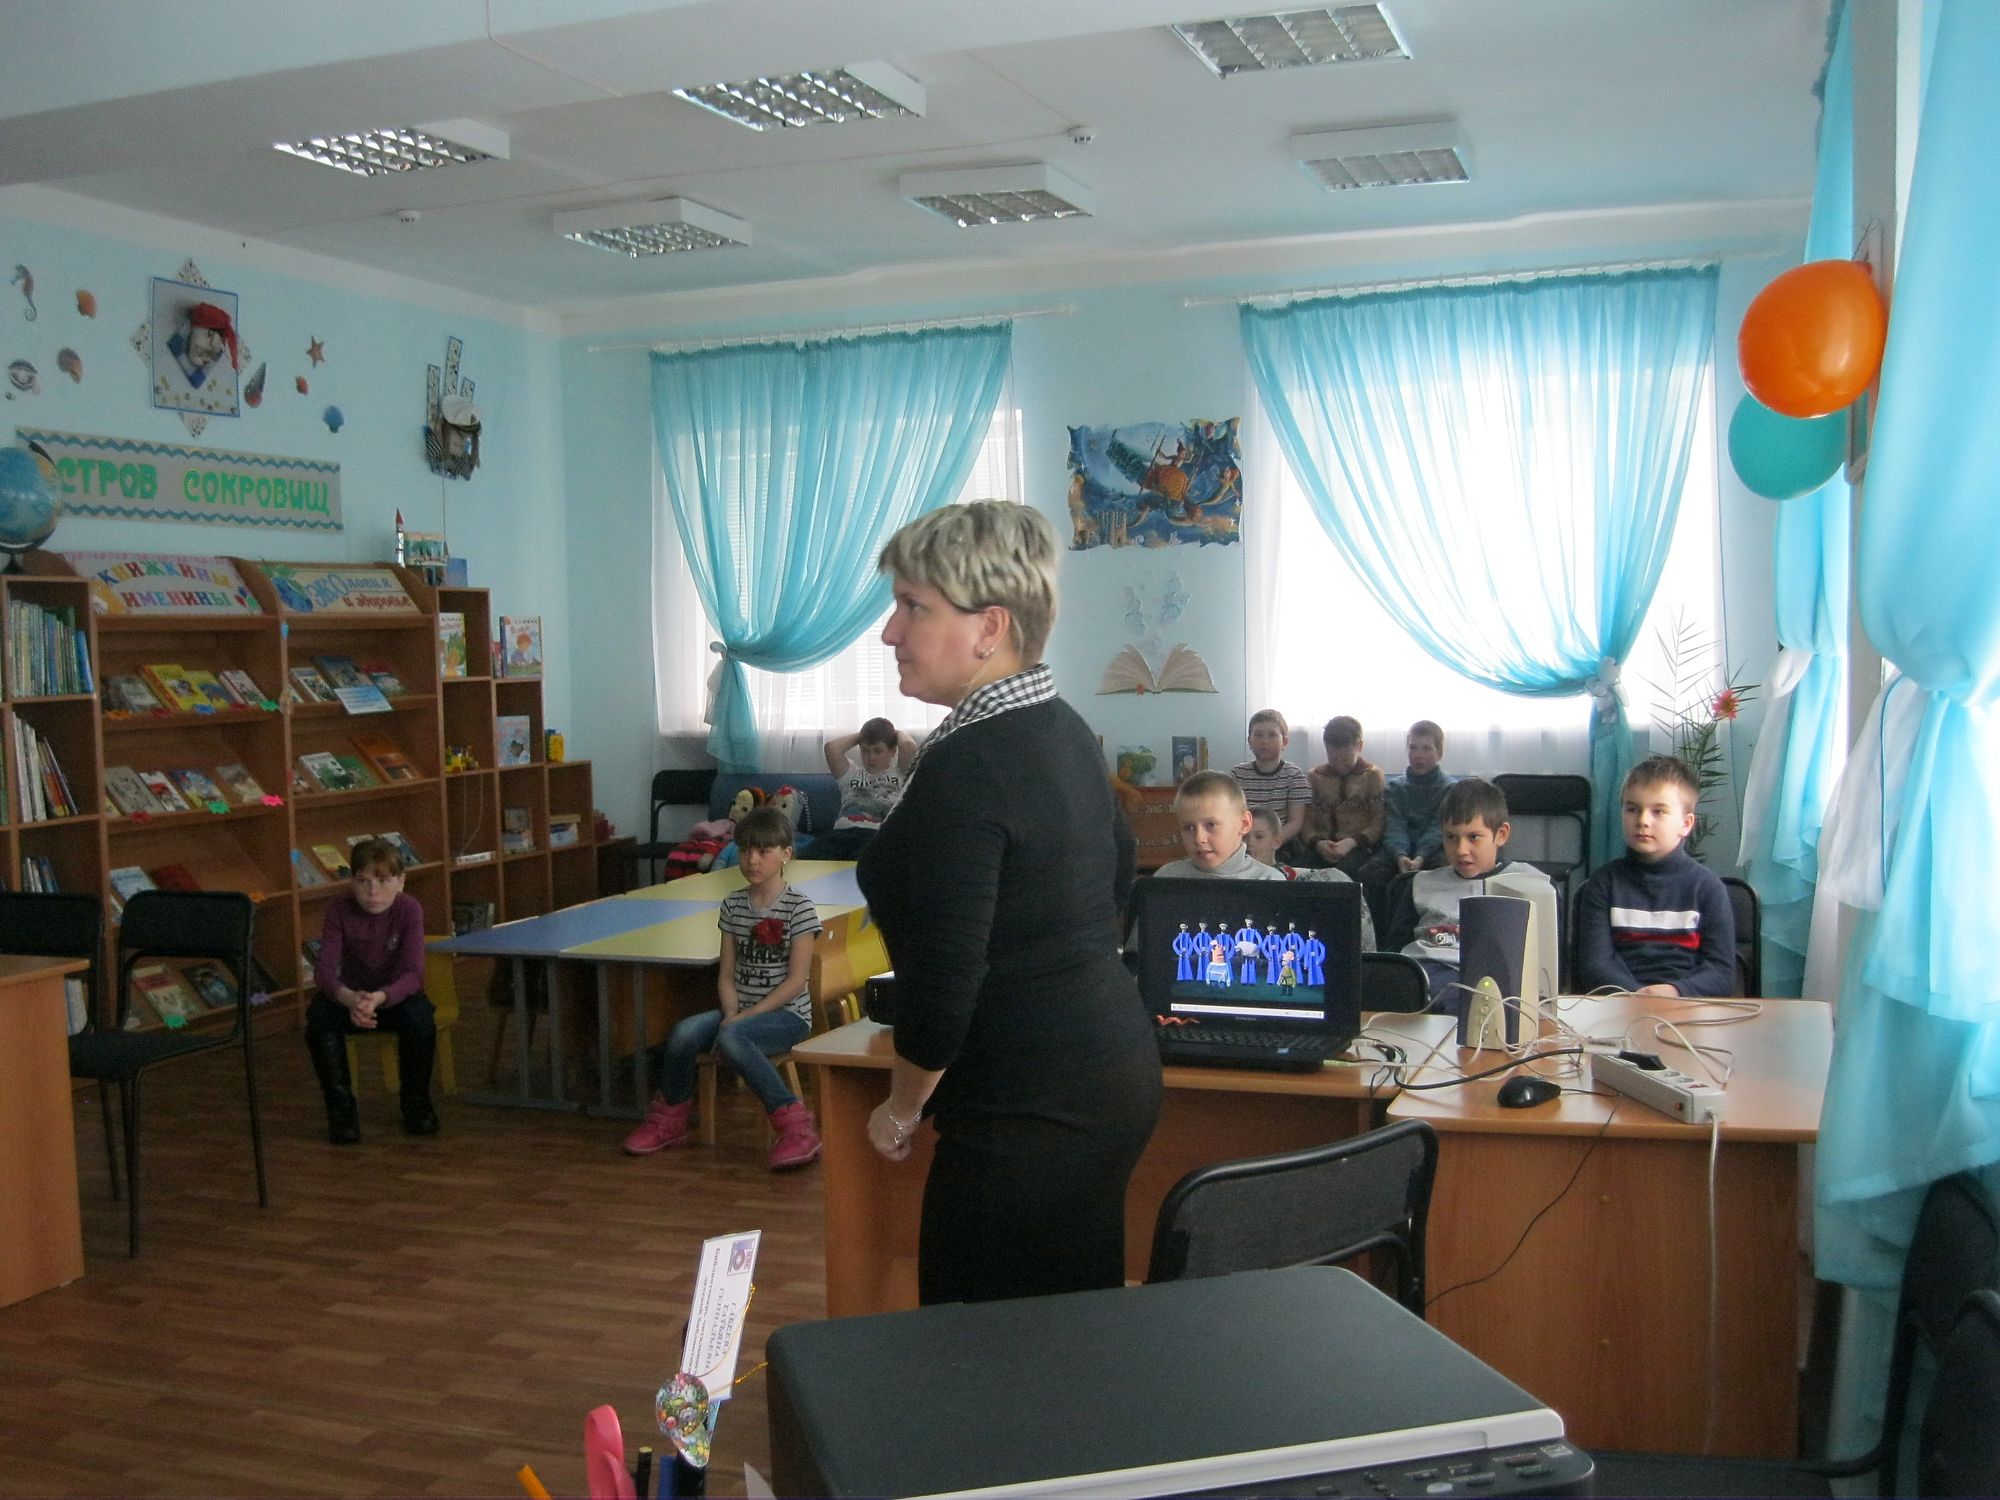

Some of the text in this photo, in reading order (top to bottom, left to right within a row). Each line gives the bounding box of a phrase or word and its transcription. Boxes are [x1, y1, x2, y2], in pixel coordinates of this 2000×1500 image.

[56, 456, 330, 516] СТРОВ СОКРОВИЩ
[97, 560, 235, 588] КНИЖКИНЫ
[120, 591, 234, 607] ИМЕНИНЫ
